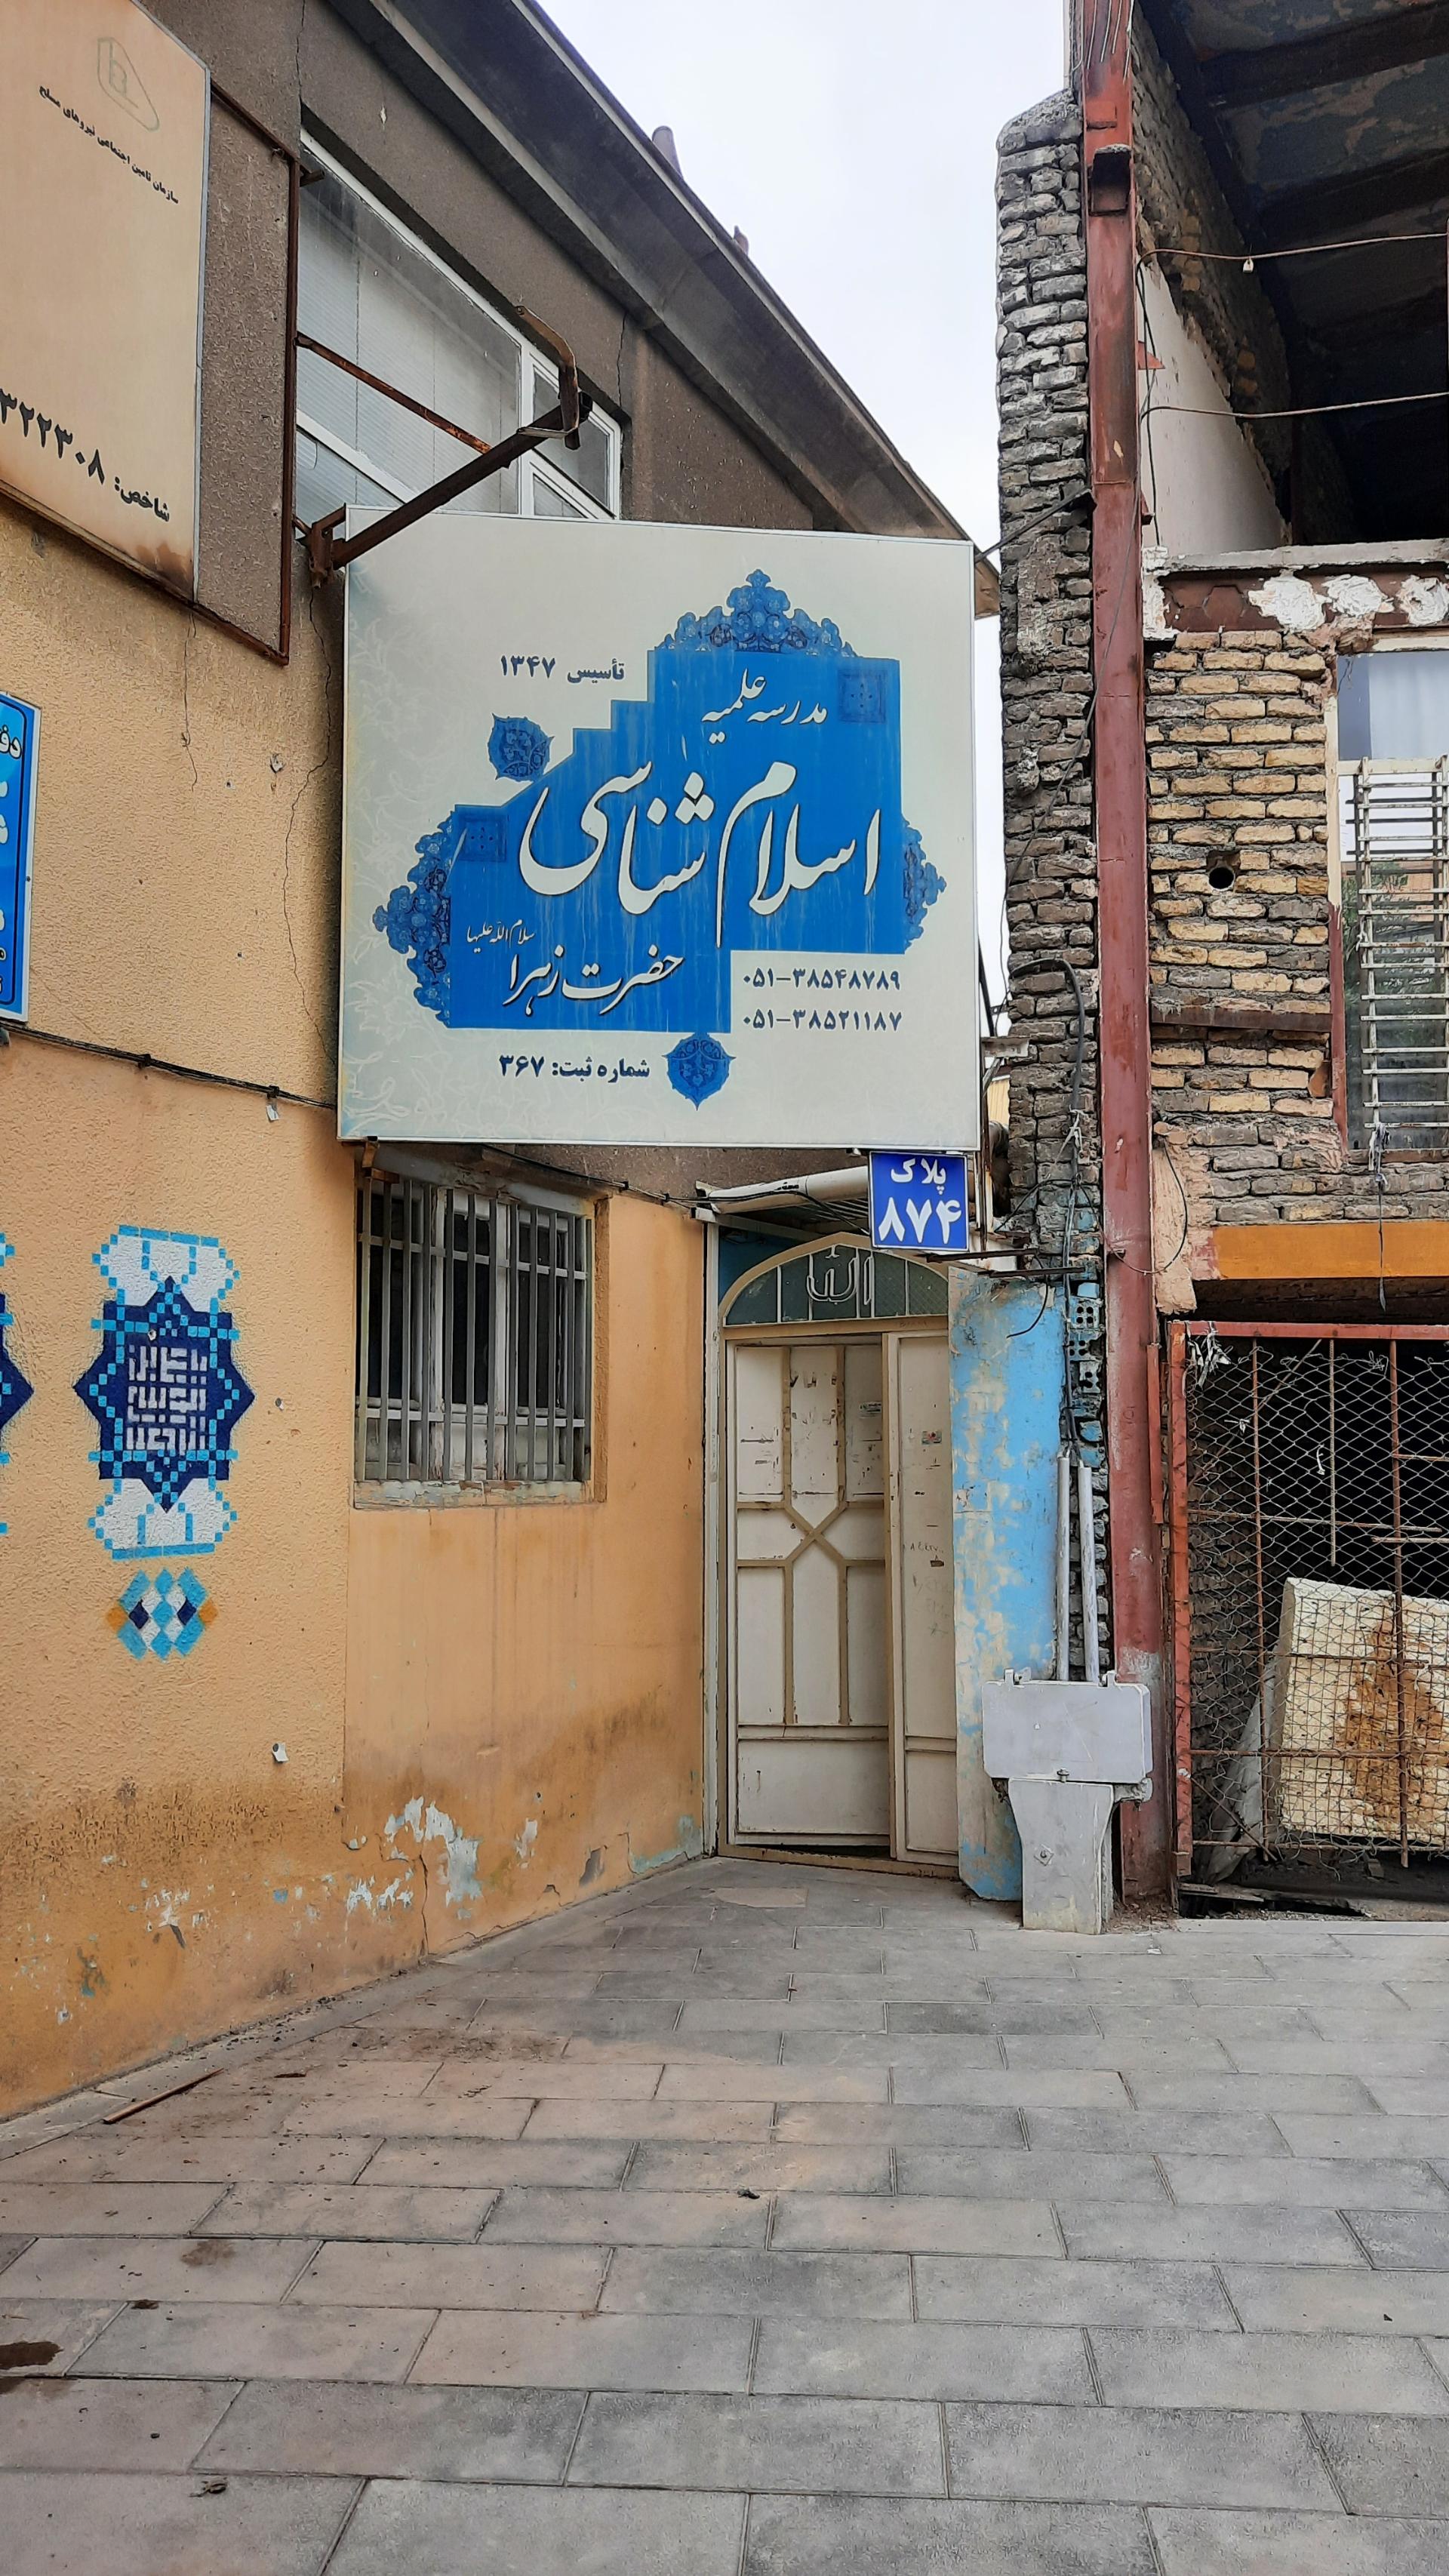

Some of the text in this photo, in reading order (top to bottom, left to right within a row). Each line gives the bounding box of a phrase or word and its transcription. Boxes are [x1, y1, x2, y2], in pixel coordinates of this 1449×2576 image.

[39, 85, 61, 108] مسلح
[97, 137, 130, 164] اجتماعی
[131, 164, 151, 181] تامین
[152, 181, 179, 204] سازمان
[114, 476, 170, 522] شاخص:
[500, 654, 625, 684] تأسیس ۱۳۴۷
[701, 667, 827, 744] مدرسه علمیه
[519, 760, 881, 949] اسلام شناسی
[502, 944, 685, 1016] حضرت زهرا
[499, 1054, 651, 1083] شماره ثبت: ۳۶۷
[890, 1158, 947, 1195] پلاک
[877, 1197, 962, 1245] ۸۷۴
